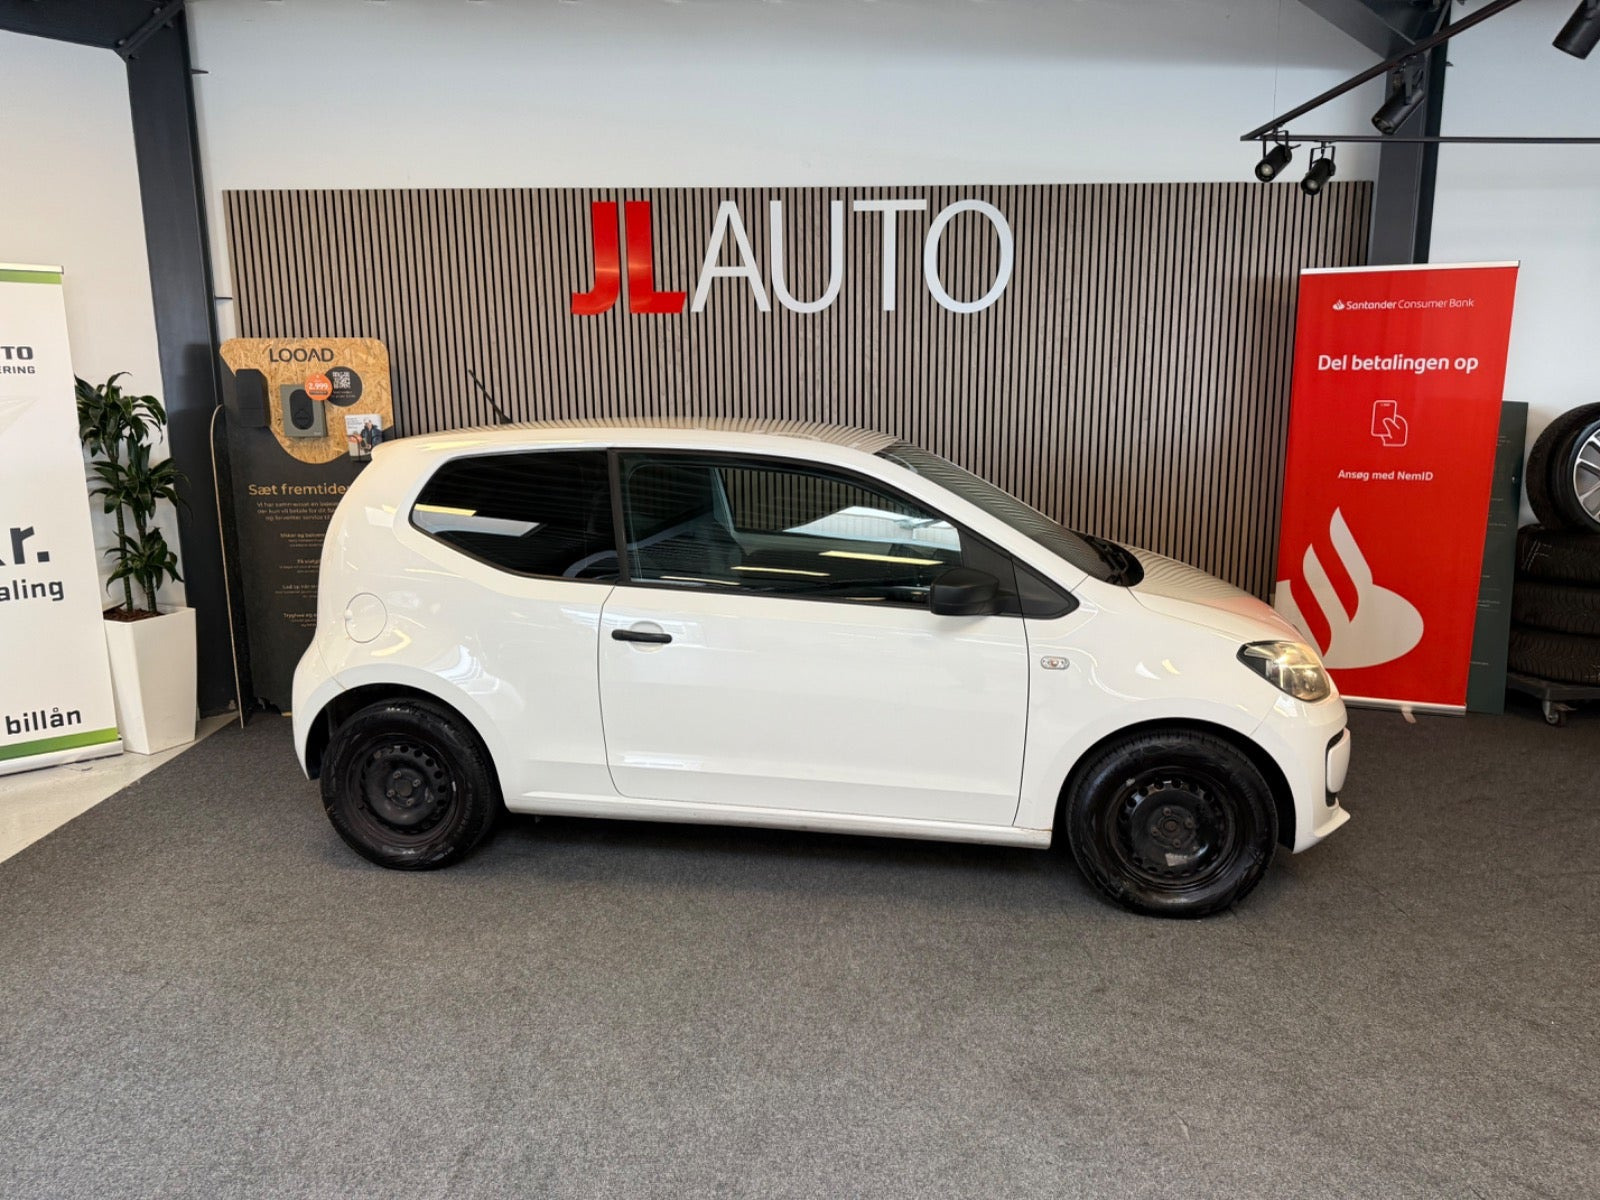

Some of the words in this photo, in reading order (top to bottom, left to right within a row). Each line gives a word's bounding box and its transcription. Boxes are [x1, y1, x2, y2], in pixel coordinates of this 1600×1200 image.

[571, 200, 687, 316] JL
[690, 198, 1014, 314] AUTO
[1346, 300, 1397, 311] Santander
[1398, 299, 1447, 309] Consumer
[1449, 298, 1474, 308] Bank
[269, 348, 334, 362] LOOAD
[0, 366, 35, 374] RING
[1318, 354, 1348, 371] Del
[1351, 354, 1450, 374] betalingen
[1454, 357, 1479, 374] op
[1337, 469, 1370, 481] Ansøg
[1372, 471, 1395, 480] med
[1397, 471, 1434, 481] NemID
[248, 484, 278, 496] Sæt
[281, 482, 348, 495] fremtide
[0, 578, 64, 602] aling
[5, 707, 82, 735] billån
